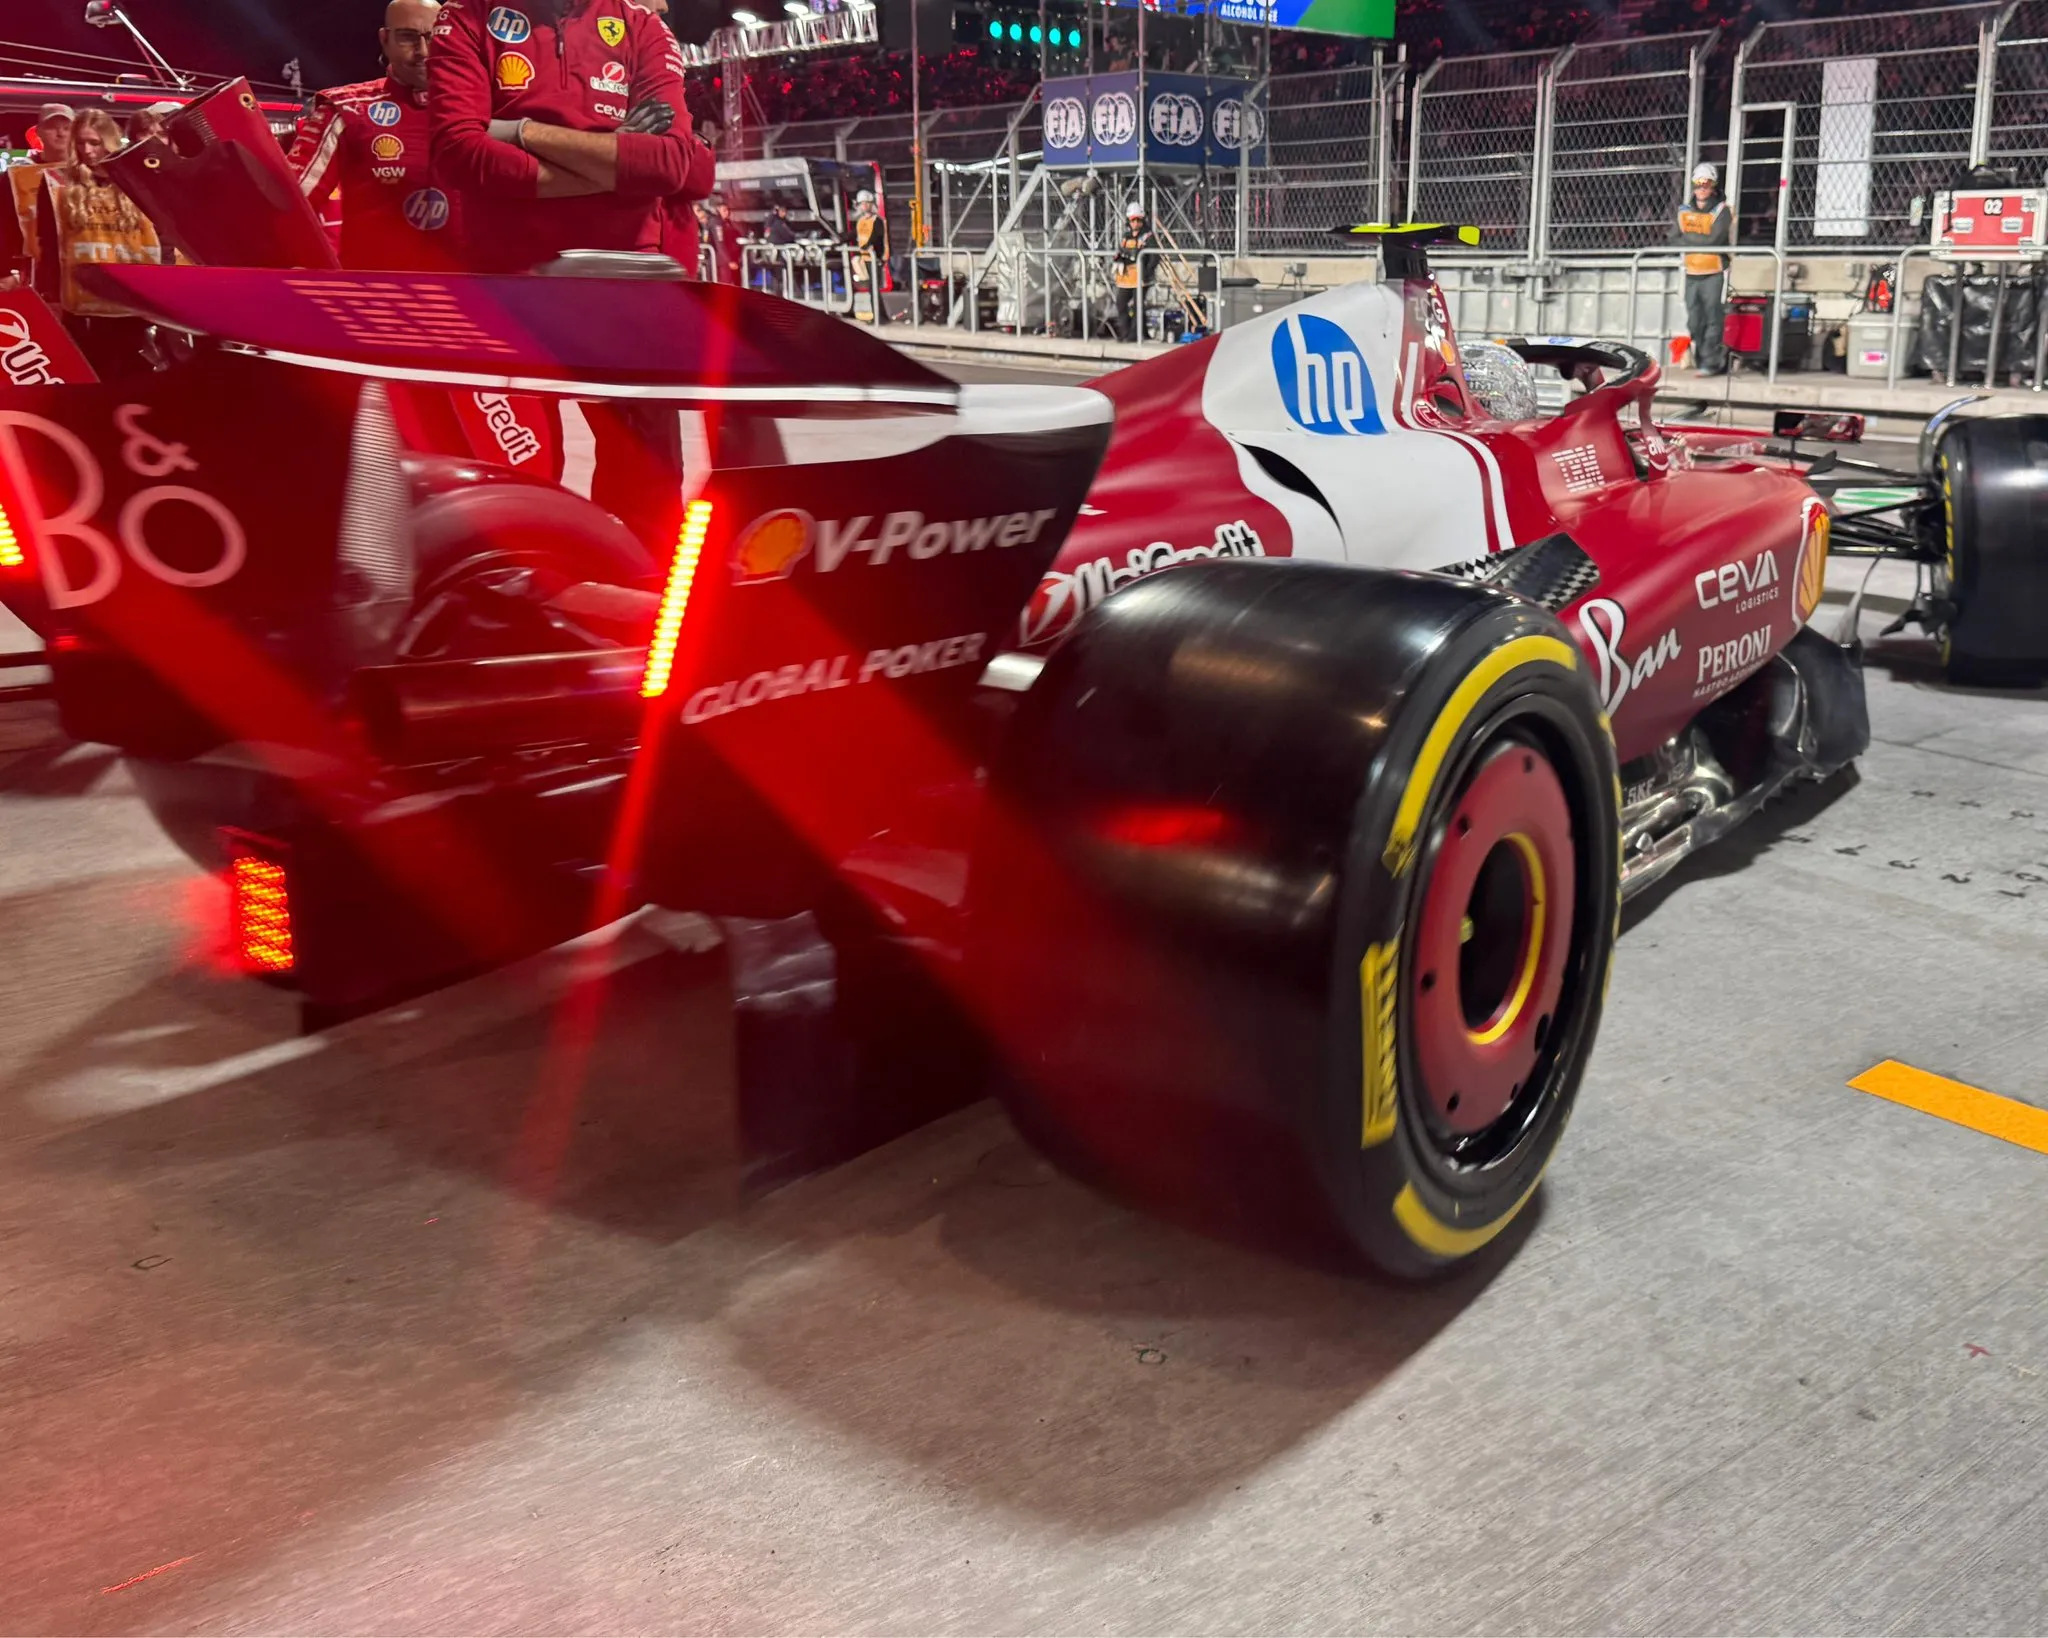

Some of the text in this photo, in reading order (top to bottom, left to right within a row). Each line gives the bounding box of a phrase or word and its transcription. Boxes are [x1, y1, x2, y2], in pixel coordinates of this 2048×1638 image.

[492, 7, 526, 42] hp
[1220, 2, 1257, 21] ALCOHOL
[371, 102, 398, 126] hp
[371, 167, 406, 179] VGW
[1984, 198, 2003, 216] 02
[1286, 313, 1366, 436] hp
[815, 508, 1057, 573] V-Power
[1735, 587, 1780, 614] LOGISTICS
[1696, 624, 1772, 685] PERONI
[681, 632, 987, 725] GLOBAL POKER
